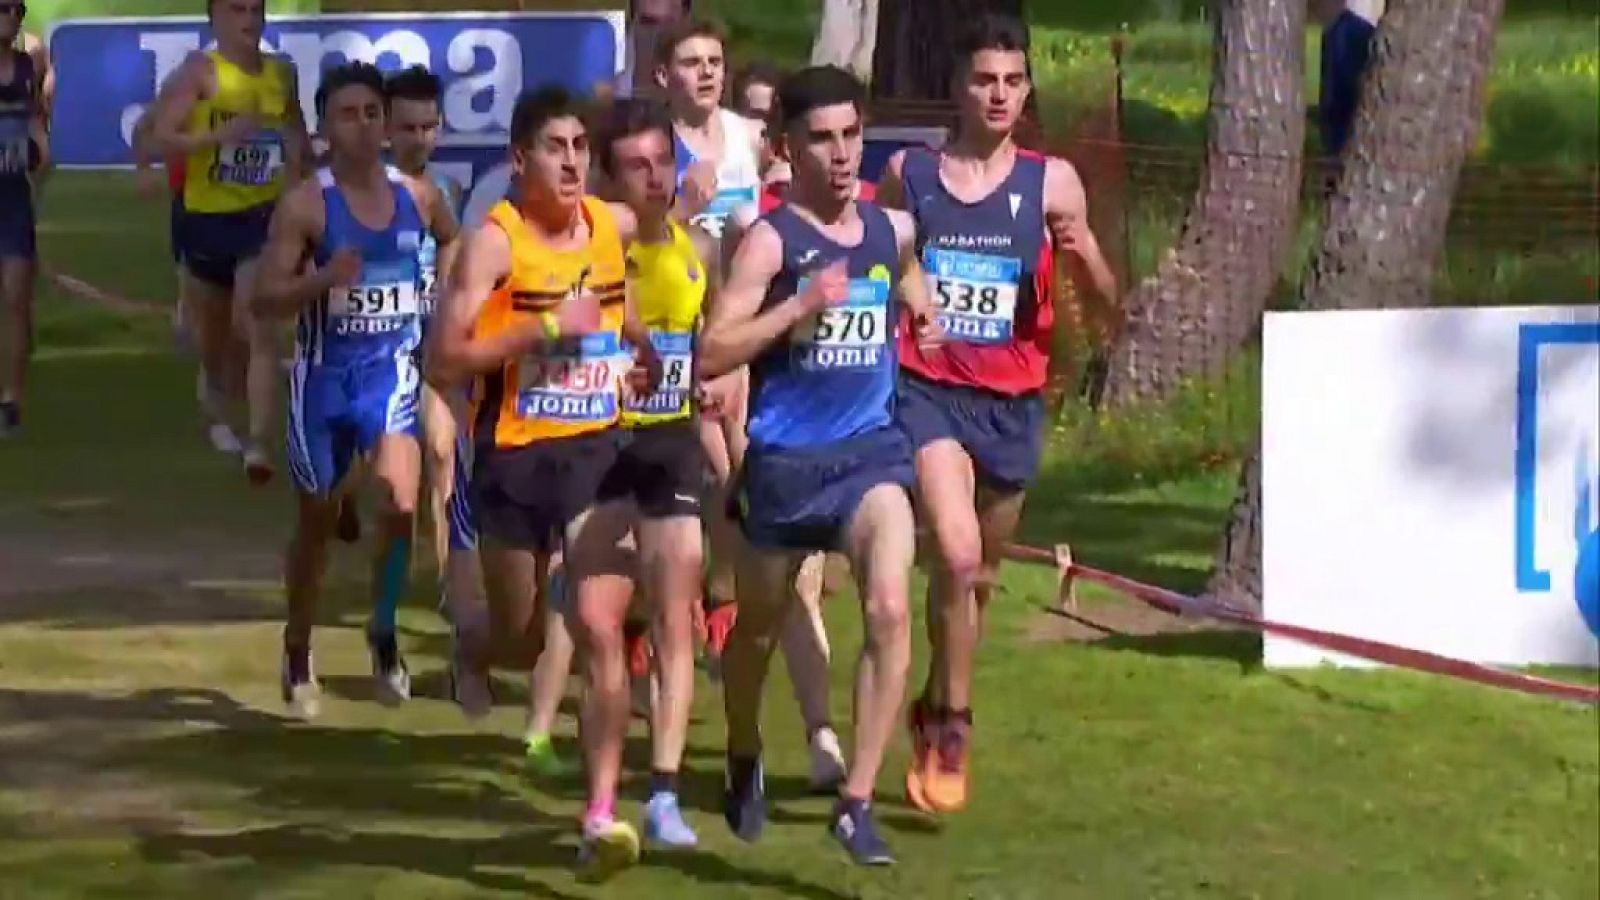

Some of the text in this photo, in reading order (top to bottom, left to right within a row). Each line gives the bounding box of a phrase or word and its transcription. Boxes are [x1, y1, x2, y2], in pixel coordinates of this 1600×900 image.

[120, 28, 522, 149] Jma
[347, 286, 399, 314] 591
[936, 280, 998, 315] 538
[814, 310, 875, 342] 570
